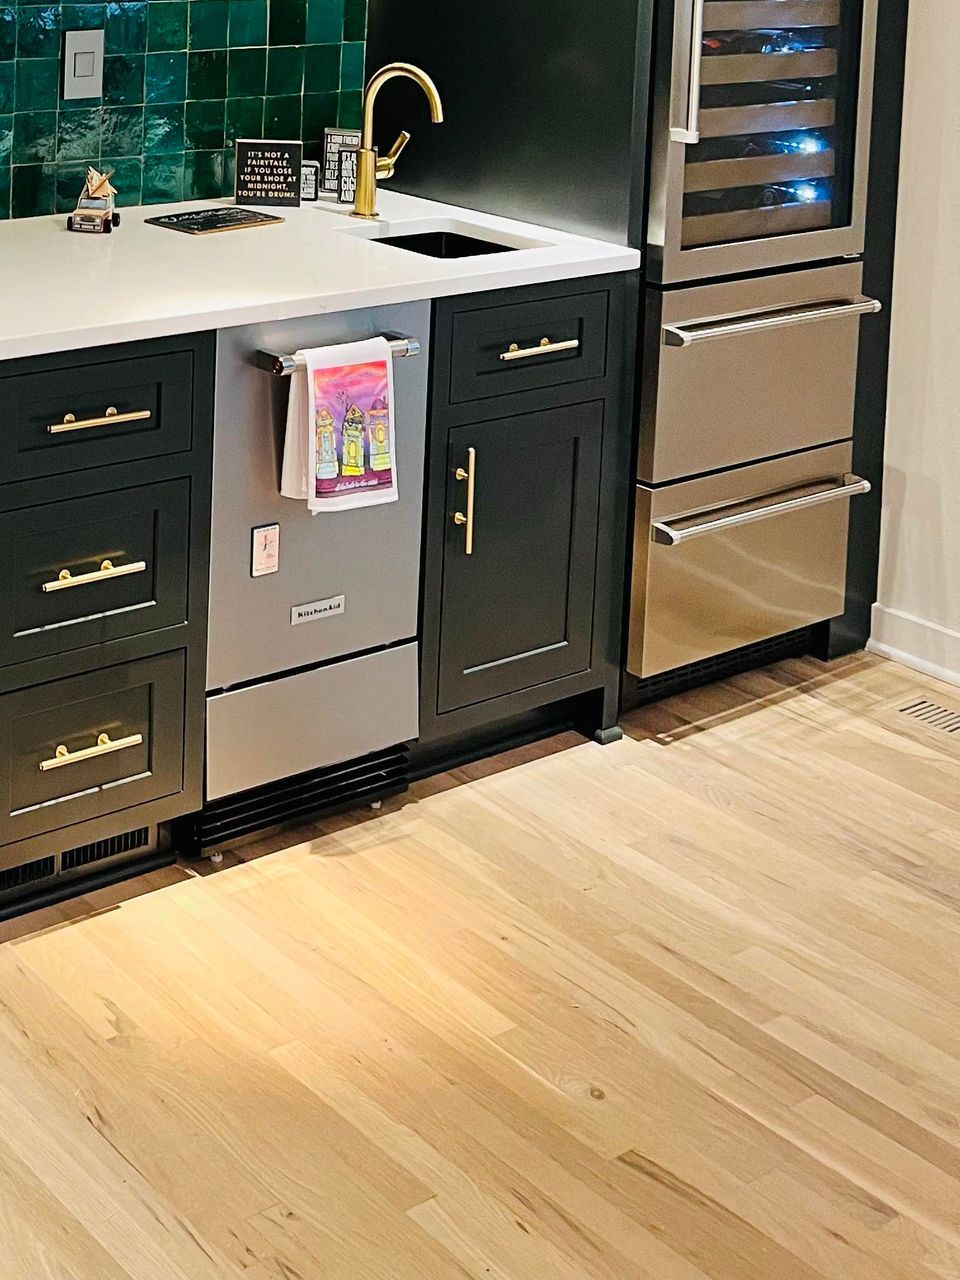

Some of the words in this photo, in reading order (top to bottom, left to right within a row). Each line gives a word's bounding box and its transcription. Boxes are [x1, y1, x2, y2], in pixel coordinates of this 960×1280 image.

[247, 158, 290, 167] FAIRYTALE.
[329, 161, 338, 169] BES
[273, 167, 292, 175] LOSE
[247, 182, 289, 191] MIDNIGHT,
[324, 179, 338, 190] WRIT
[297, 602, 341, 618] KitchenAid
